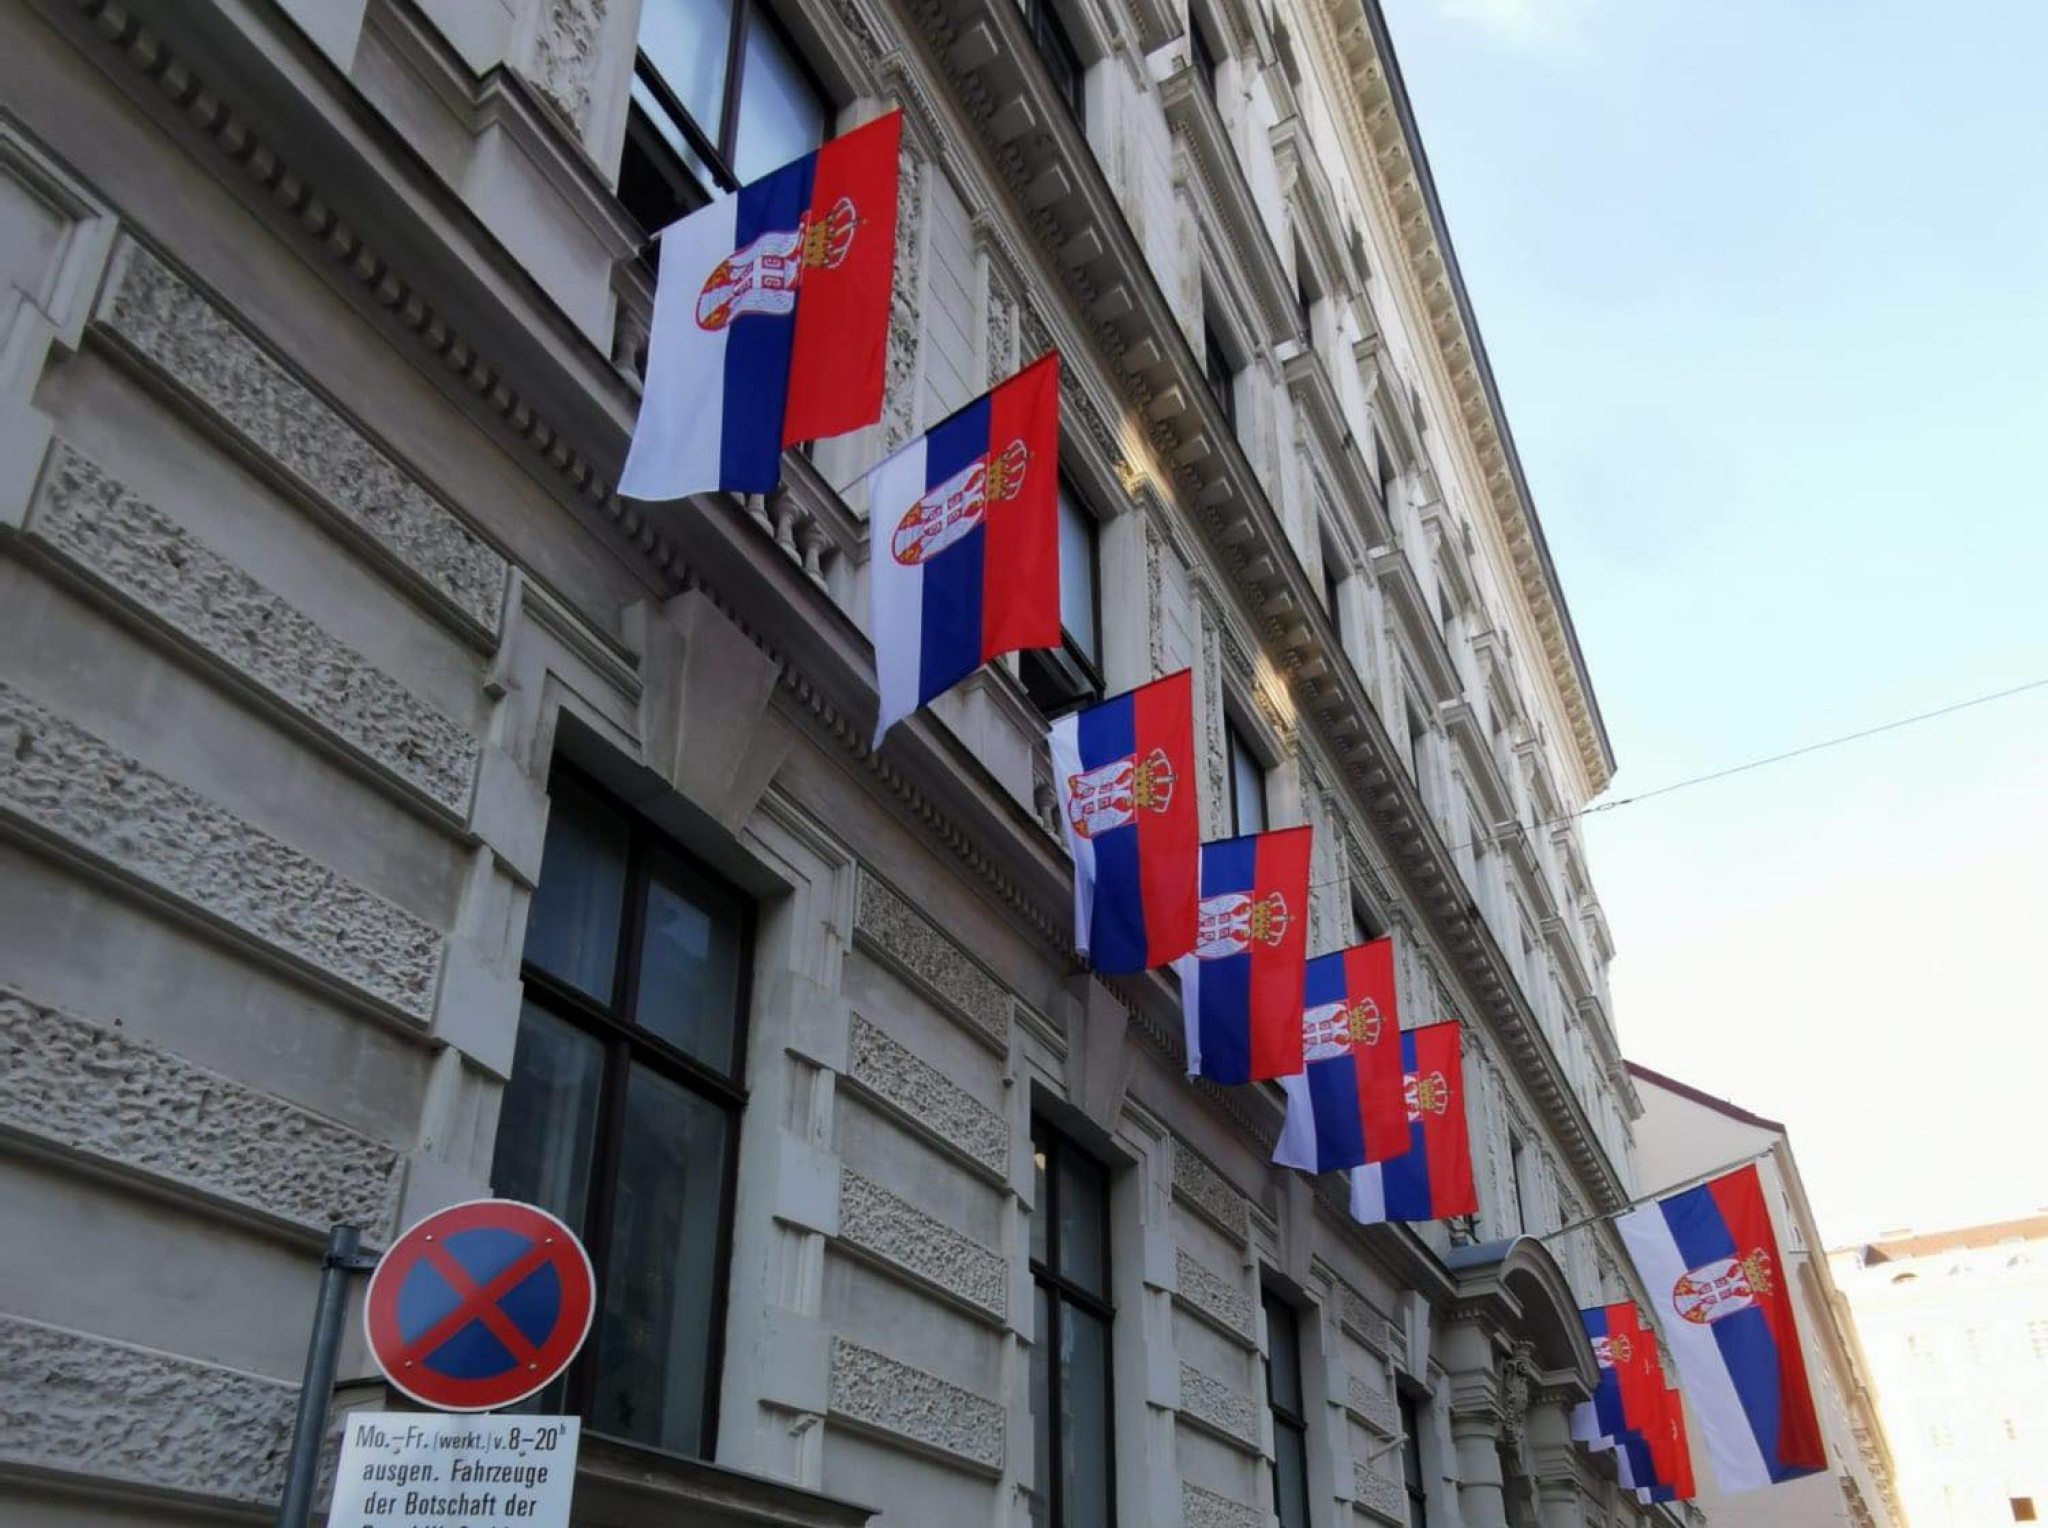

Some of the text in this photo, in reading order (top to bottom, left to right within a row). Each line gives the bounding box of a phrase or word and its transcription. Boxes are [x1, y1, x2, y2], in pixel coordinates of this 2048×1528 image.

[362, 1458, 548, 1489] ausgen. Fahrzeuge
[363, 1490, 537, 1517] der Botschaft der
